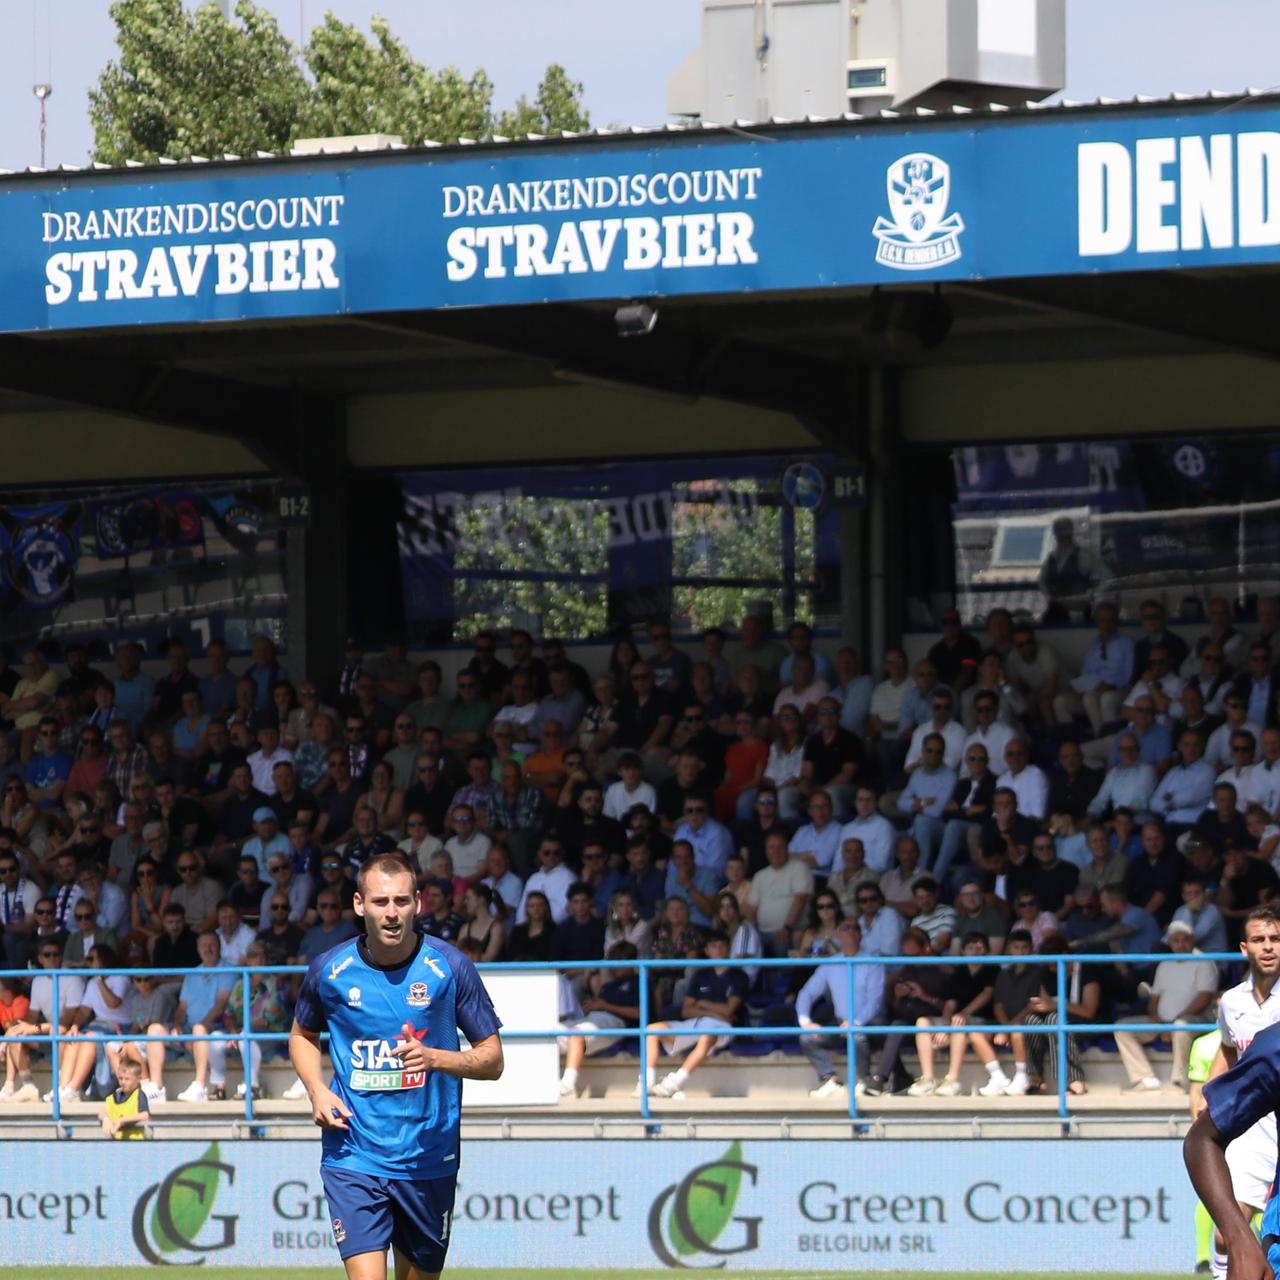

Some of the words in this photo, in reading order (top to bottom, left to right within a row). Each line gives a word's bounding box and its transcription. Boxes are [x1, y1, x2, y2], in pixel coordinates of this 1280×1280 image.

[442, 167, 763, 218] DRANKENDISCOUNT
[42, 195, 345, 243] DRANKENDISCOUNT
[446, 211, 758, 282] STRAVBIER
[45, 238, 340, 305] STRAVBIER
[833, 475, 864, 498] B1-1
[279, 496, 309, 517] B1-2
[351, 1039, 405, 1070] STA
[354, 1073, 400, 1088] SPORT
[405, 1073, 422, 1087] TV
[452, 1183, 621, 1237] oncept
[798, 1180, 946, 1225] Green
[964, 1180, 1171, 1239] Concept
[273, 1232, 337, 1249] BELGI
[798, 1235, 891, 1252] BELGIUM
[899, 1235, 934, 1252] SRL
